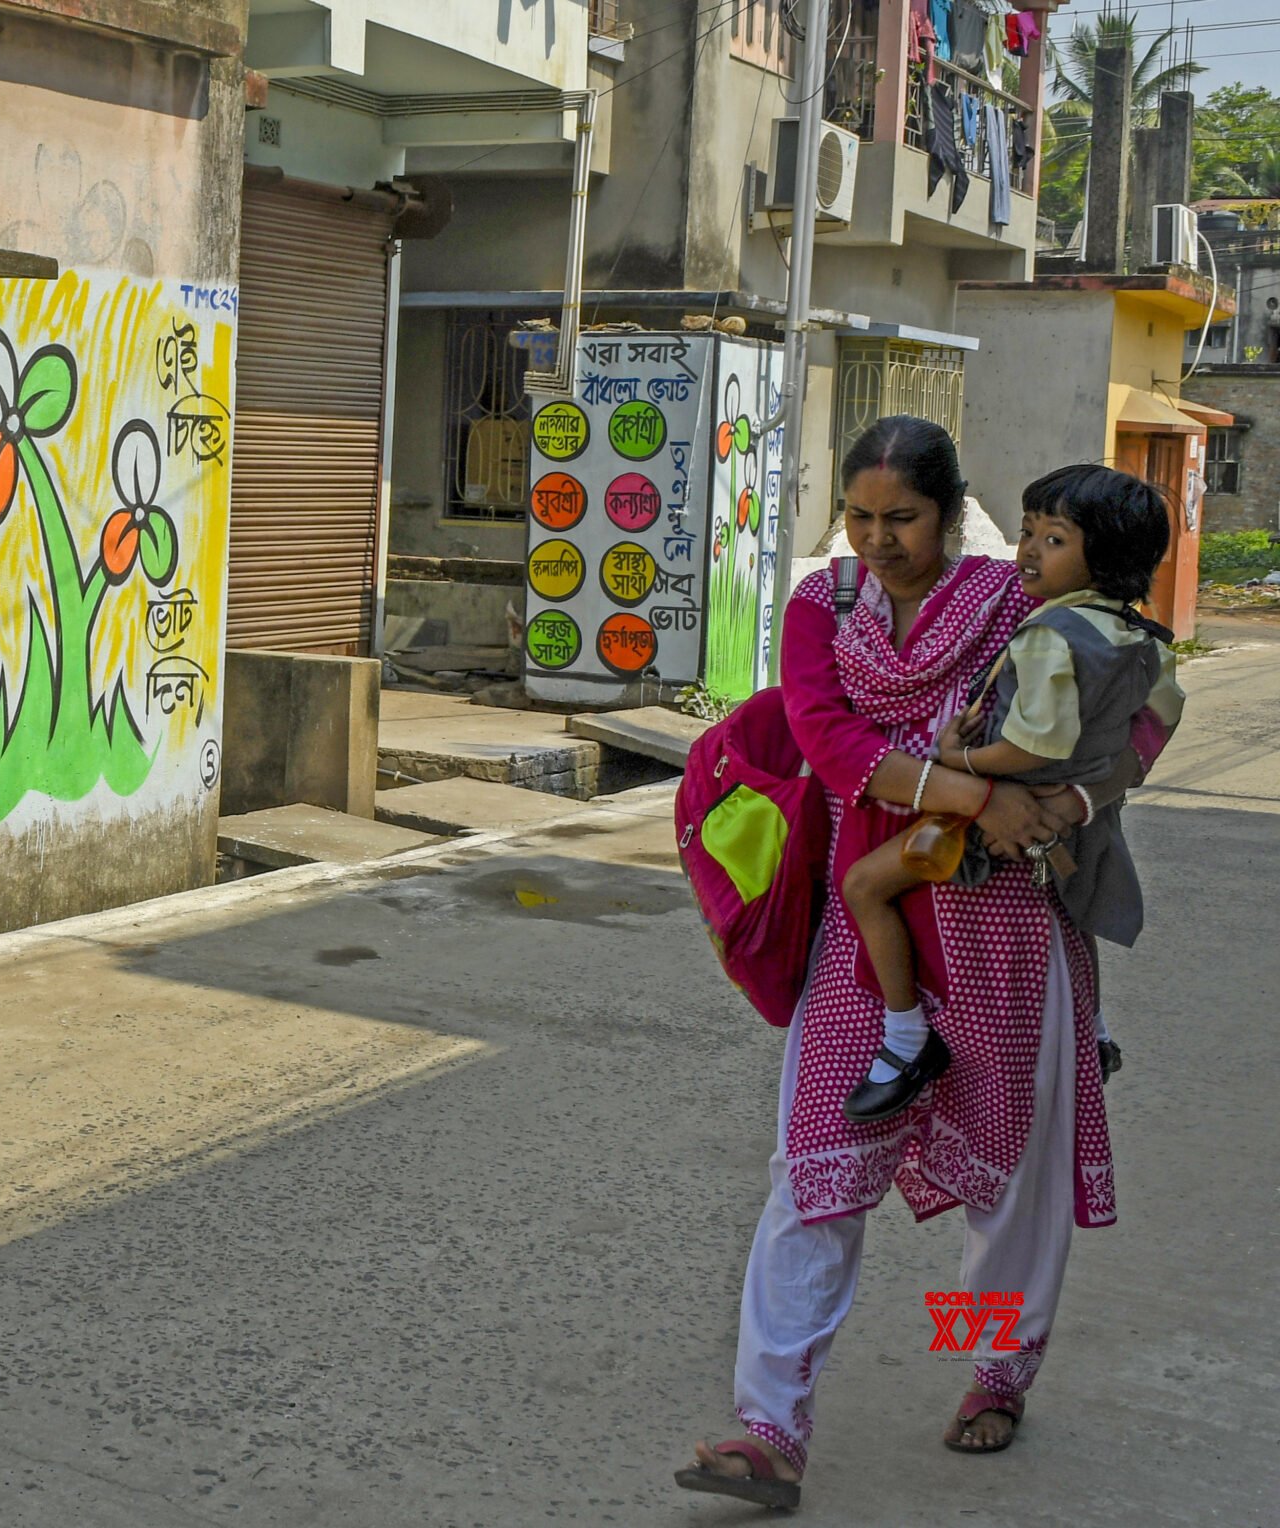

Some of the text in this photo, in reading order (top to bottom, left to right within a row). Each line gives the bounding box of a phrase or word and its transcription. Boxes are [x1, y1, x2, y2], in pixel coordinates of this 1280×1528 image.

[582, 335, 699, 380] এরা সবাই
[647, 373, 696, 405] জোট
[654, 562, 696, 597] সব
[534, 618, 572, 639] সবুজ
[649, 599, 701, 632] ভোট
